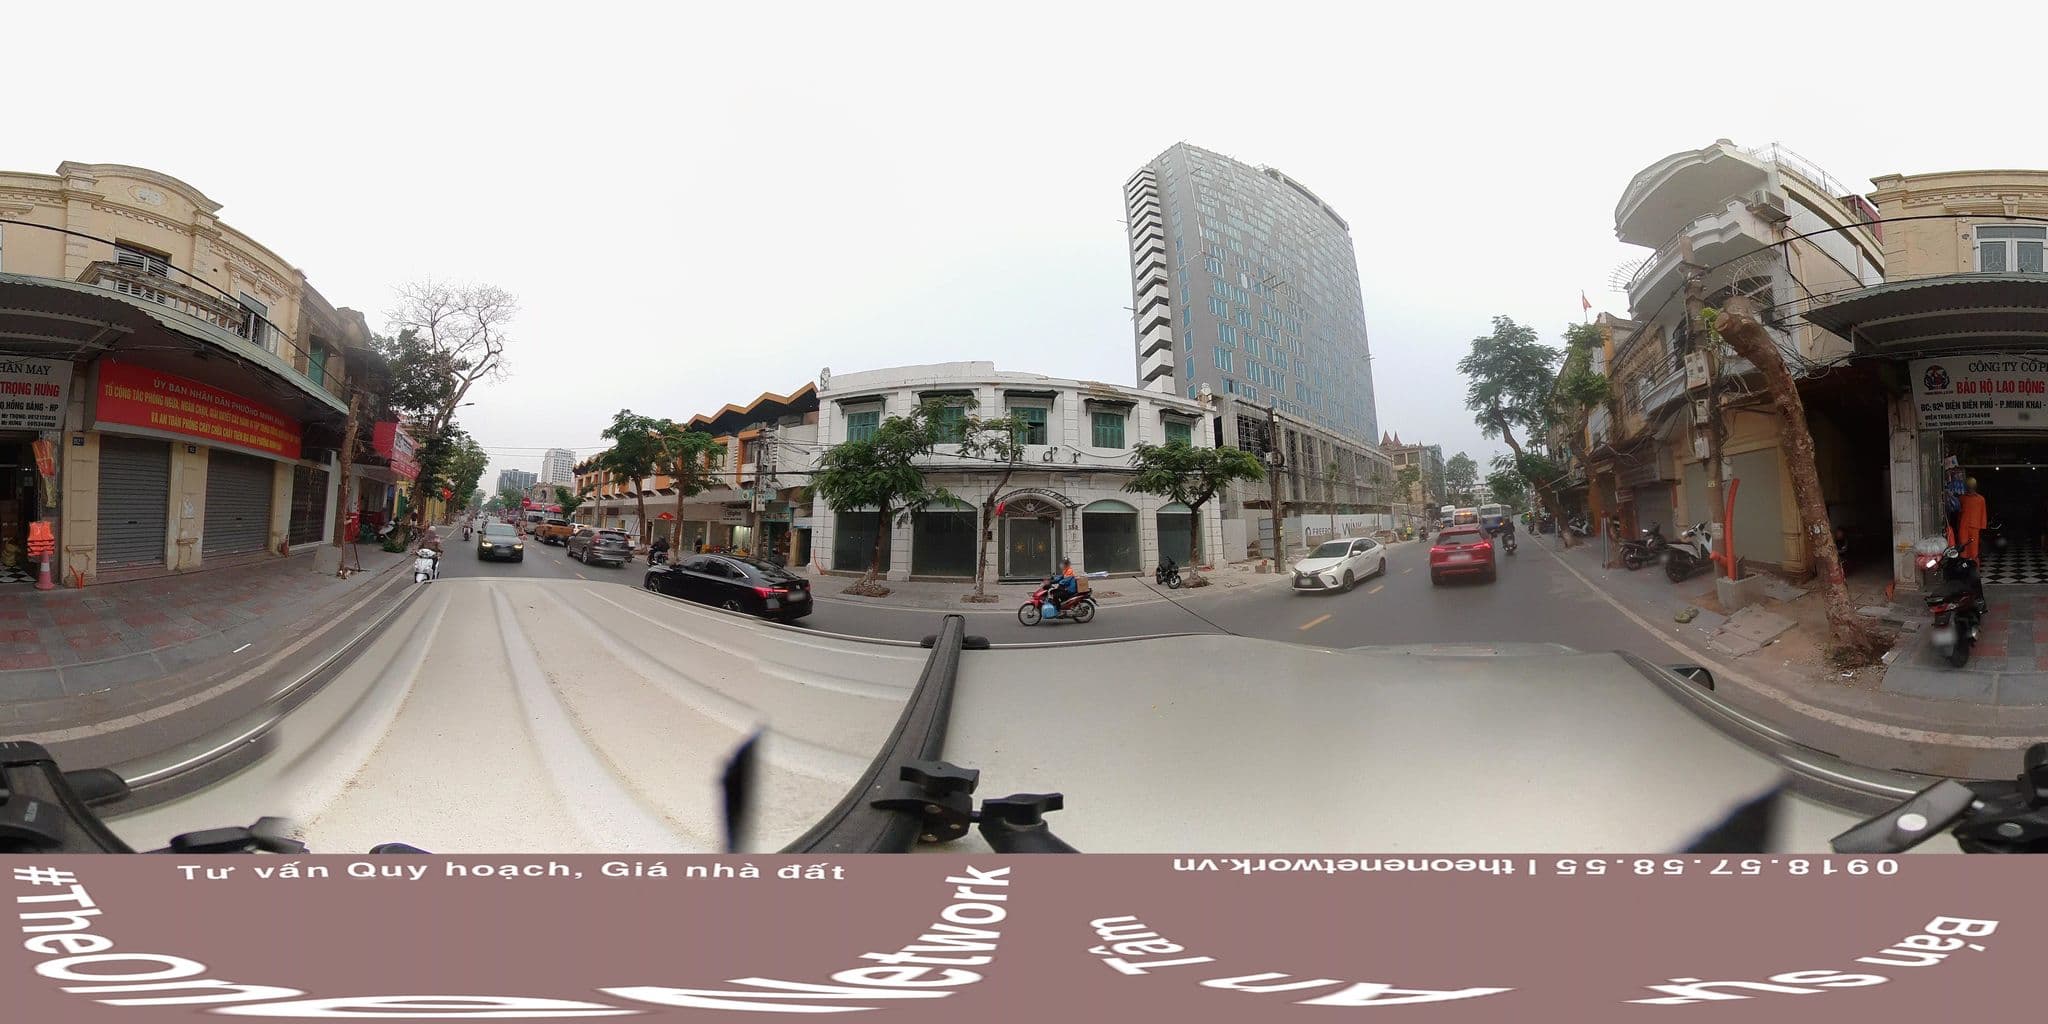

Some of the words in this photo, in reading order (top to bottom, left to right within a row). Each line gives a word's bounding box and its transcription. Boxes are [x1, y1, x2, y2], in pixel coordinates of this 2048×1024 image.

[25, 364, 51, 375] MAY
[1968, 359, 2000, 373] CÔNG
[2002, 361, 2018, 372] TY
[0, 381, 31, 397] TRỌNG
[34, 381, 60, 397] HƯNG
[114, 384, 132, 400] CÔNG
[132, 387, 144, 402] TÁC
[153, 377, 167, 390] ỦY
[168, 383, 187, 395] BAN
[190, 387, 213, 403] NHÂN
[1956, 377, 1977, 394] BẢO
[1980, 378, 1994, 396] HỘ
[1996, 380, 2015, 394] LAO
[2018, 378, 2045, 396] ĐỘNG
[2025, 400, 2042, 409] KHAI
[159, 413, 168, 425] AN
